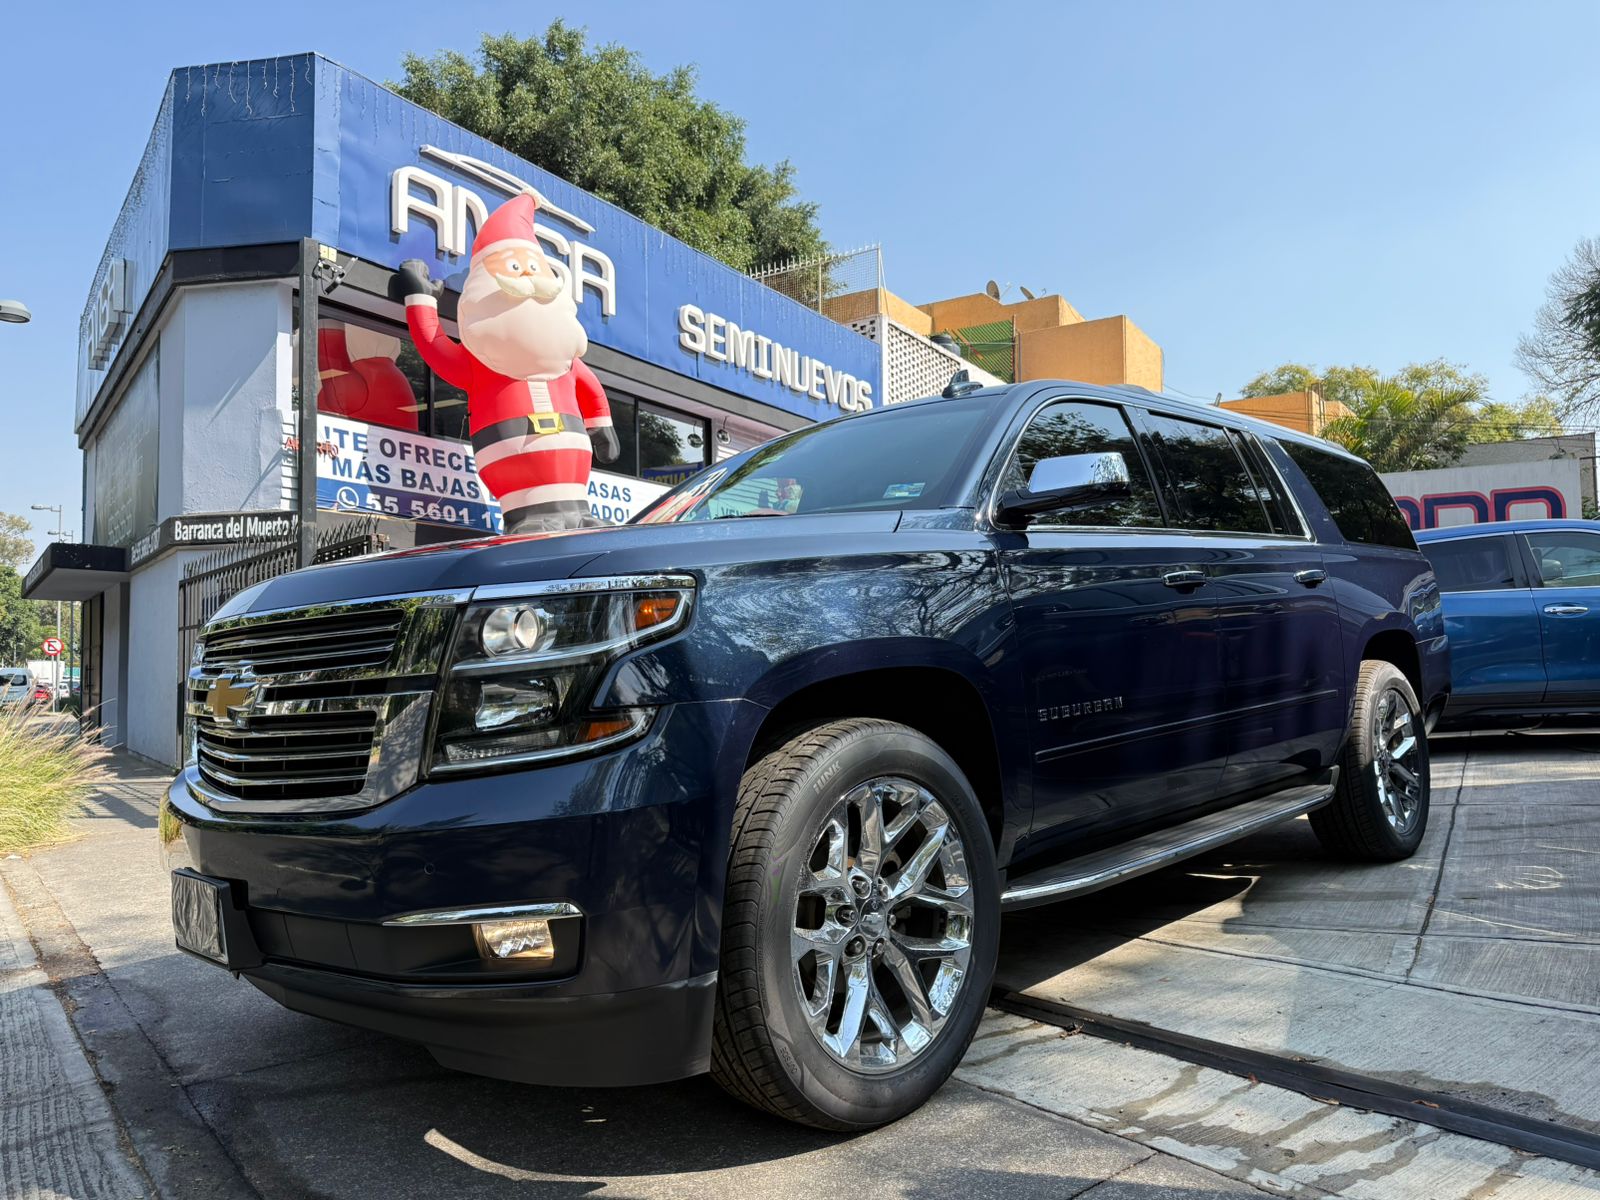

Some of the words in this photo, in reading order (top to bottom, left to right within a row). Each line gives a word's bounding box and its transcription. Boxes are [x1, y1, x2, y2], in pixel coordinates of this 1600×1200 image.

[679, 304, 873, 412] SEMINUEVOS
[331, 456, 391, 484] MÁS
[401, 468, 480, 499] BAJAS
[366, 492, 399, 514] 55
[411, 500, 470, 525] 5601
[174, 520, 224, 541] Barranca
[225, 516, 244, 539] del
[246, 516, 290, 538] Muerto
[1037, 696, 1123, 722] SUBURBAN
